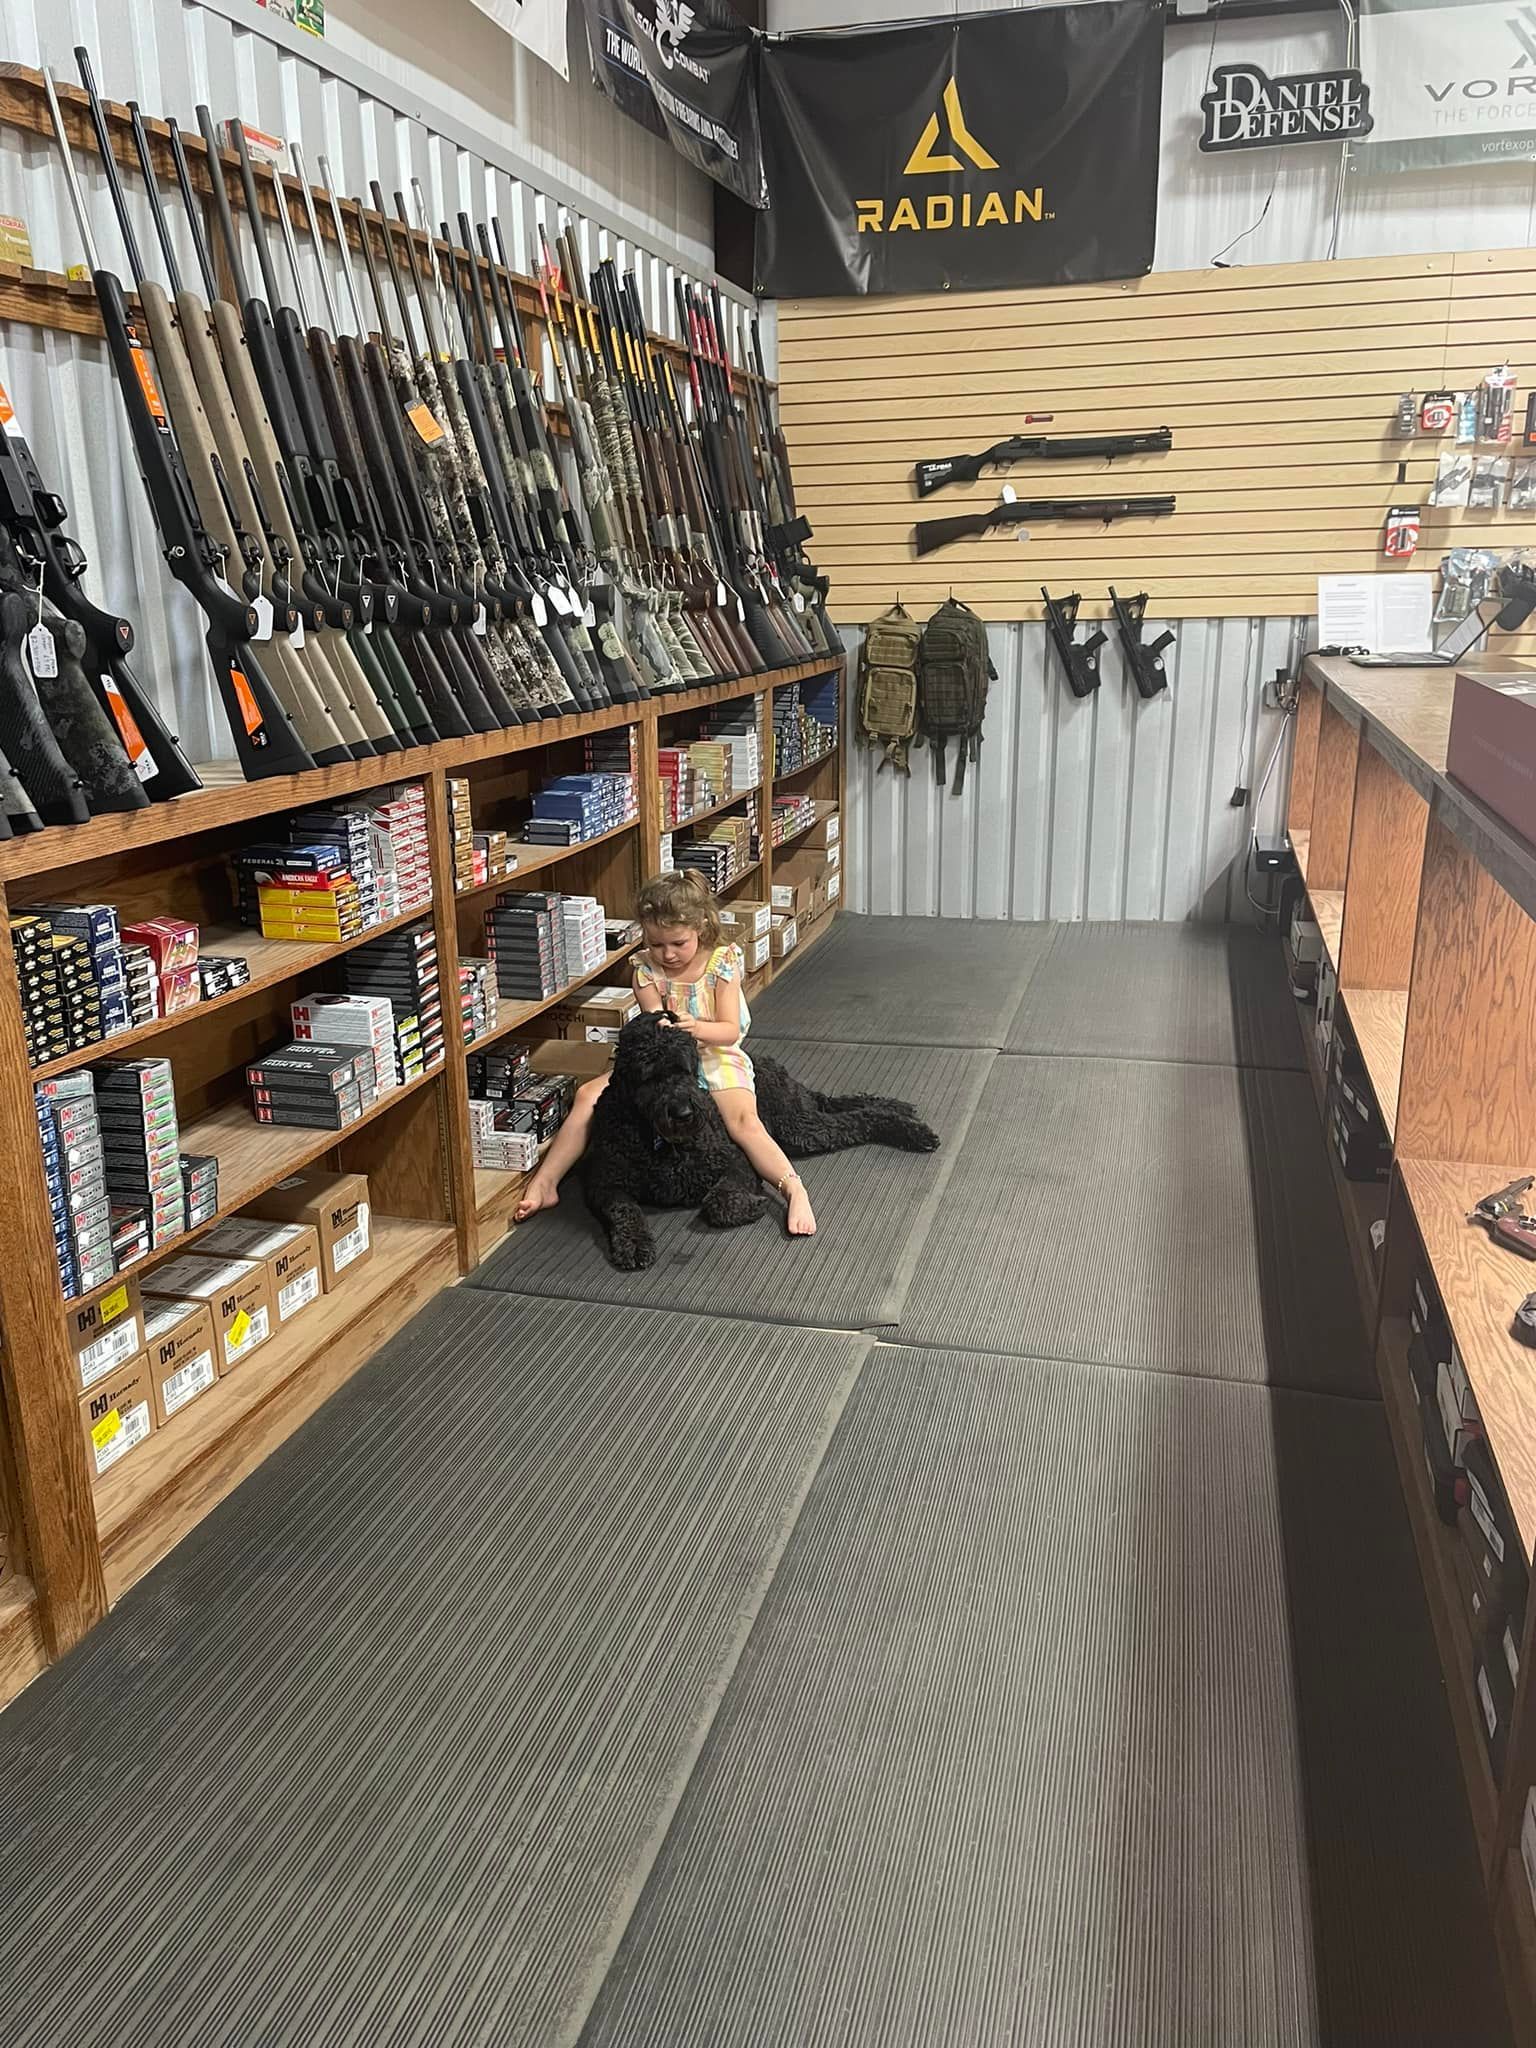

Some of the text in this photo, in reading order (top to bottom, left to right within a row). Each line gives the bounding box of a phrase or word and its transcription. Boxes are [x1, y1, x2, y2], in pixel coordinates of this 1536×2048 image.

[606, 28, 621, 60] THE
[673, 47, 711, 84] COMBAT
[1221, 73, 1361, 116] DANIEL
[1209, 100, 1364, 144] DEFENSE
[1433, 102, 1536, 126] THE FORCE
[1481, 136, 1536, 154] vortexop
[855, 187, 1044, 233] RADIAN
[176, 1326, 204, 1349] Hornady
[109, 1376, 141, 1403] Hornady
